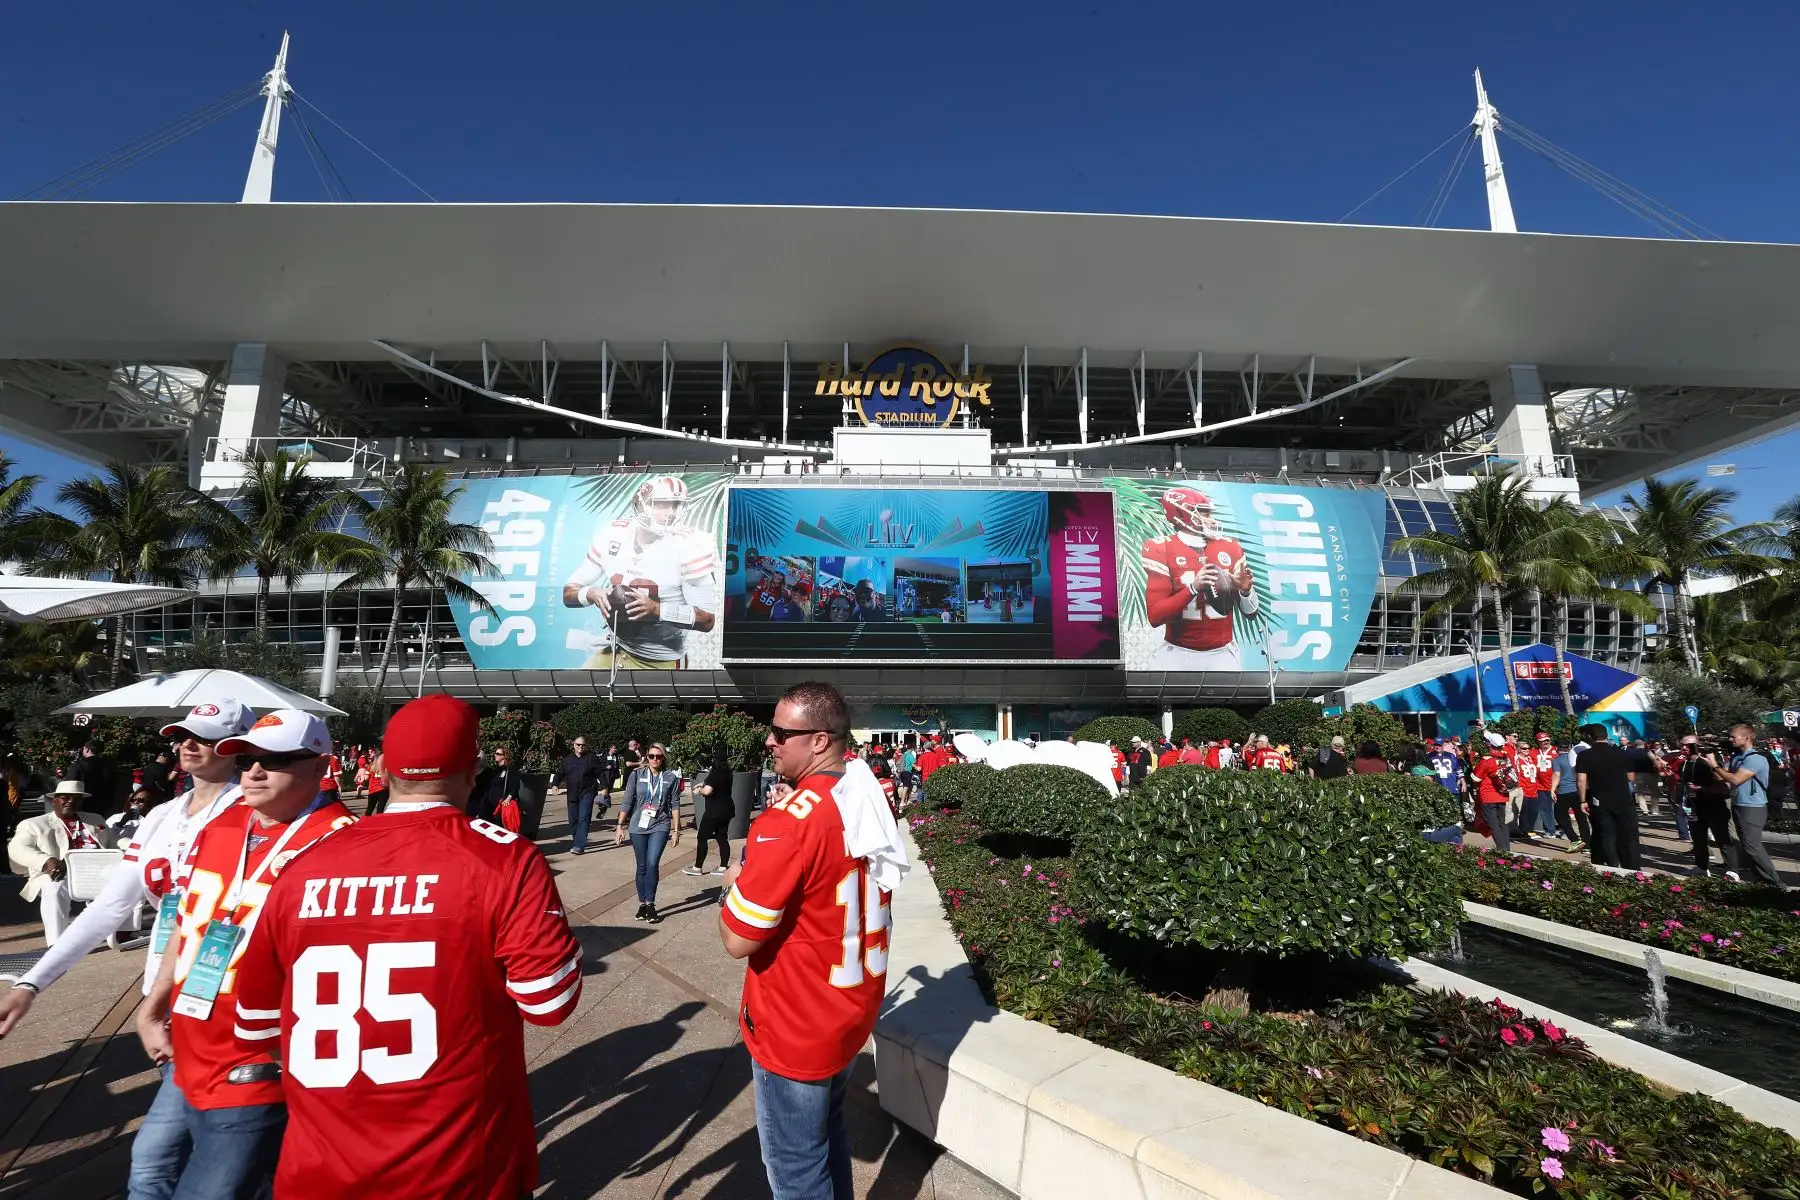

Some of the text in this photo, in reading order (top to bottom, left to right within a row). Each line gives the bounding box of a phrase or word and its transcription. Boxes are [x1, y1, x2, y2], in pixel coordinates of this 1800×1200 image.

[815, 361, 994, 406] Hard Rock
[874, 411, 938, 424] STADIUM
[469, 489, 552, 648] 49ERS
[1064, 531, 1098, 543] LIV
[1327, 525, 1350, 623] KANSAS CITY
[1065, 544, 1103, 622] MIAMI
[1252, 492, 1334, 661] CHIEFS
[772, 789, 823, 820] 15
[298, 874, 440, 919] KITTLE
[829, 868, 893, 988] 15
[288, 941, 439, 1089] 85
